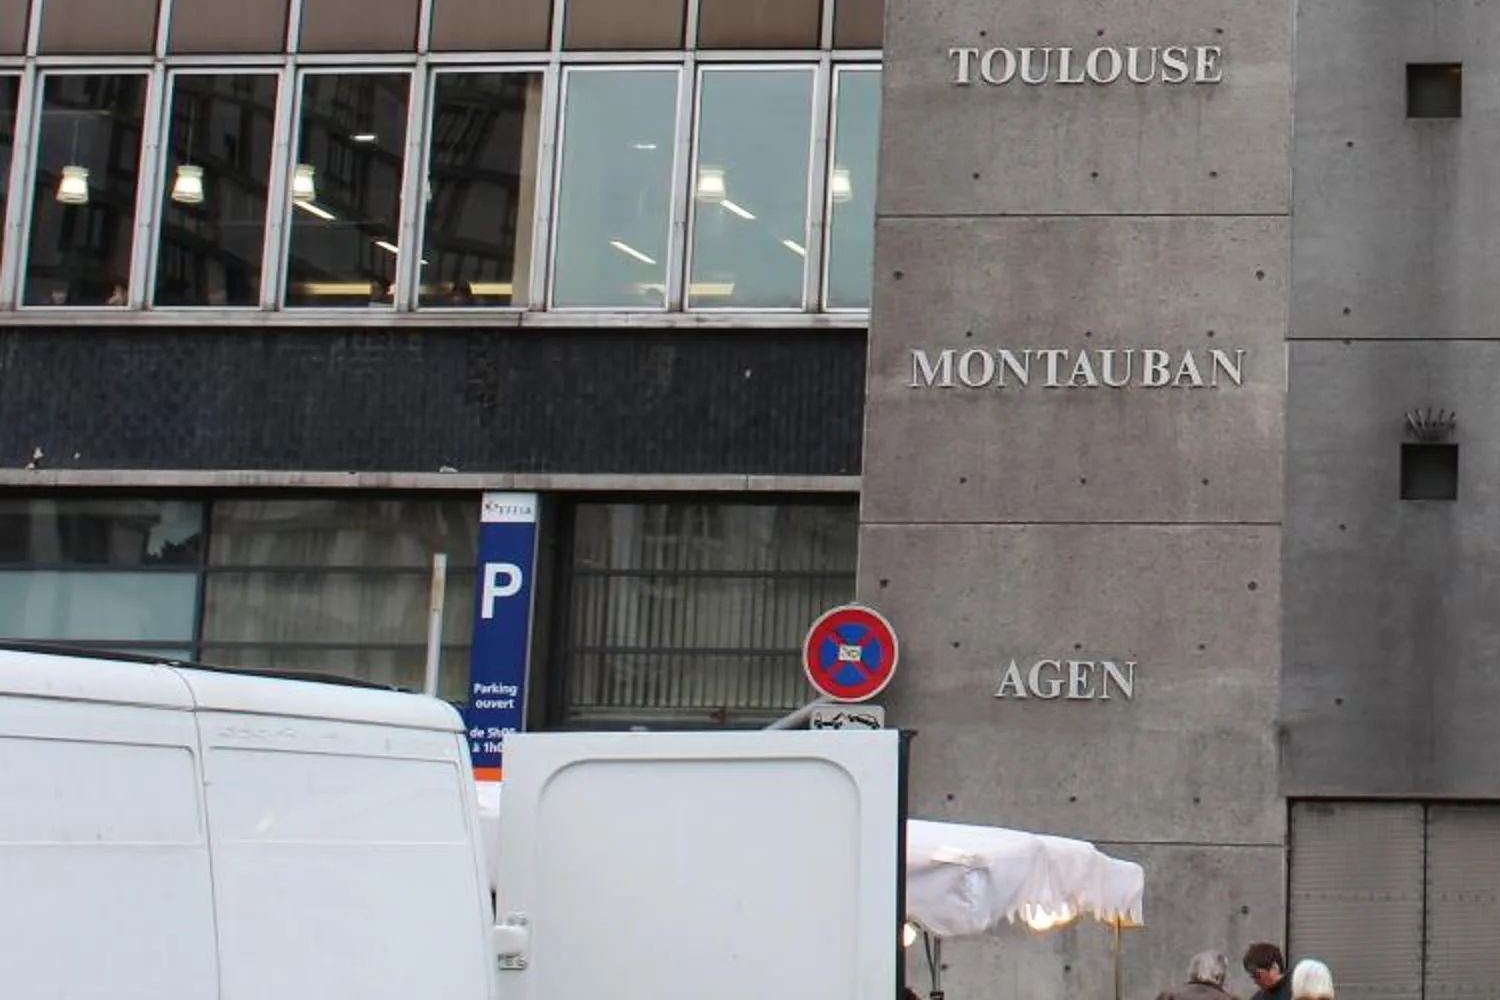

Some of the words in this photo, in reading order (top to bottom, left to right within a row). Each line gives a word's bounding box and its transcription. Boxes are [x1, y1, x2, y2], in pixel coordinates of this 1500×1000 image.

[948, 44, 1223, 85] TOULOUSE
[909, 348, 1244, 388] MONTAUBAN
[480, 562, 523, 619] P
[473, 683, 518, 697] Parking
[995, 660, 1137, 700] AGEN
[475, 699, 515, 709] ouvert
[469, 727, 485, 739] de
